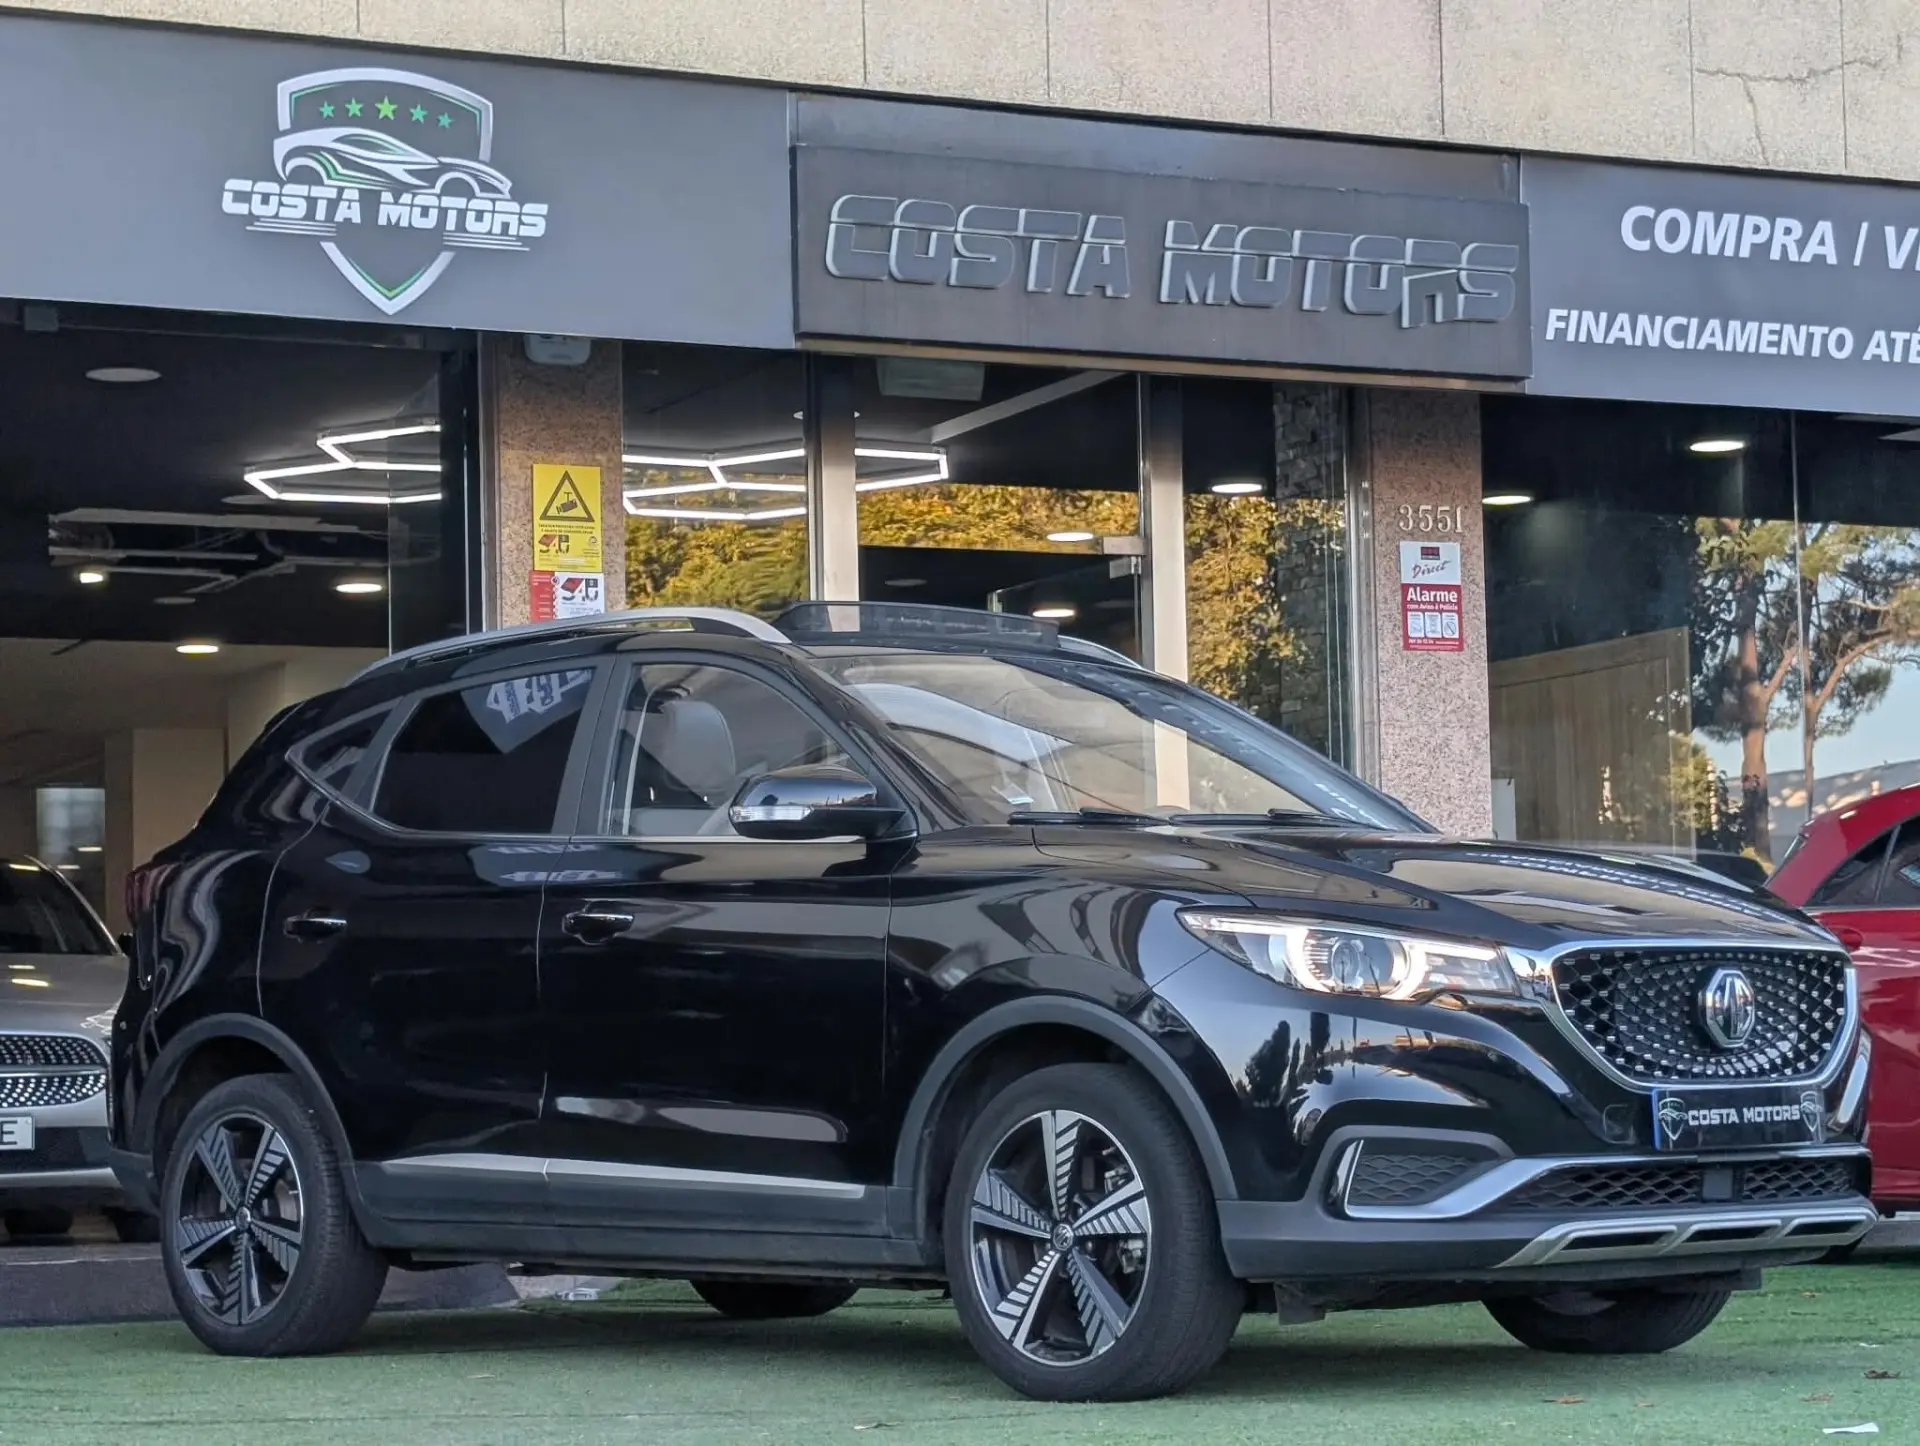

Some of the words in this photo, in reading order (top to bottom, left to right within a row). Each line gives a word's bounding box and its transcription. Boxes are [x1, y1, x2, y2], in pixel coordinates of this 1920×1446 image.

[222, 178, 361, 224] COSTA
[377, 191, 549, 238] MOTORS
[1620, 206, 1838, 265] COMPRA
[1884, 225, 1920, 271] V
[825, 193, 1131, 299] COSTA
[1160, 218, 1520, 329] MOTORS
[1545, 308, 1854, 360] FINANCIAMENTO
[1399, 504, 1463, 533] 3551
[1412, 560, 1452, 578] Direct
[1407, 586, 1458, 602] Alarme
[1688, 1108, 1740, 1126] COSTA
[1742, 1105, 1800, 1123] MOTORS
